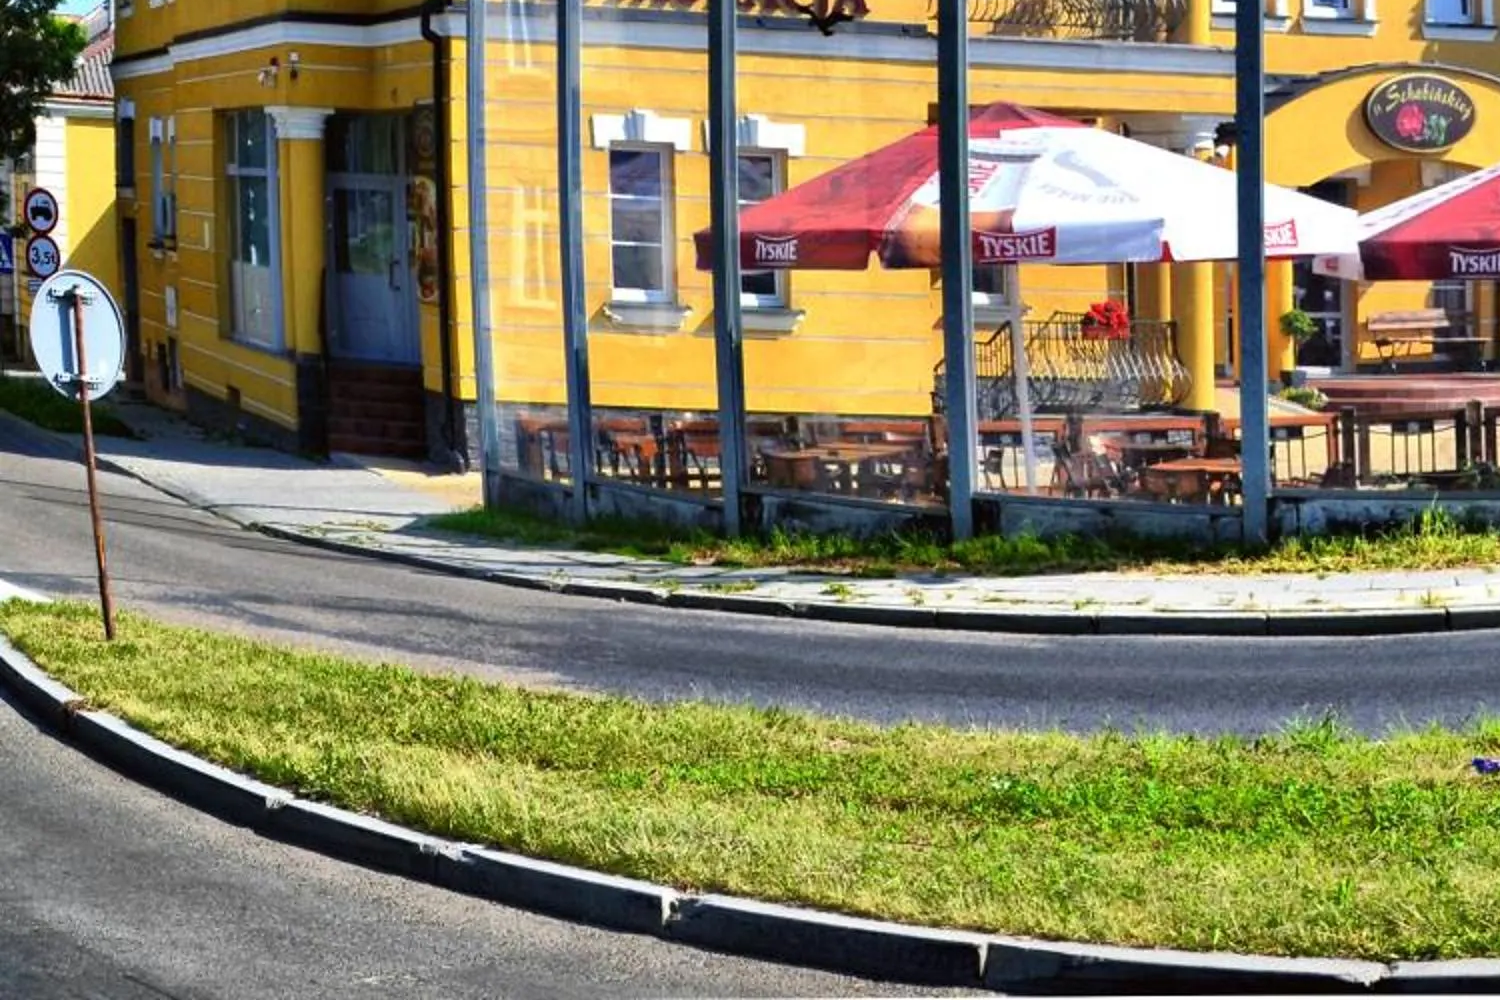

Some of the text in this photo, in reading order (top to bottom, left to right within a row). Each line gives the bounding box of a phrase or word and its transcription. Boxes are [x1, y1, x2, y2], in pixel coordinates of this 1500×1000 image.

[31, 246, 58, 266] 3,5t
[755, 239, 799, 261] TYSKIE
[979, 233, 1052, 259] TYSKIE
